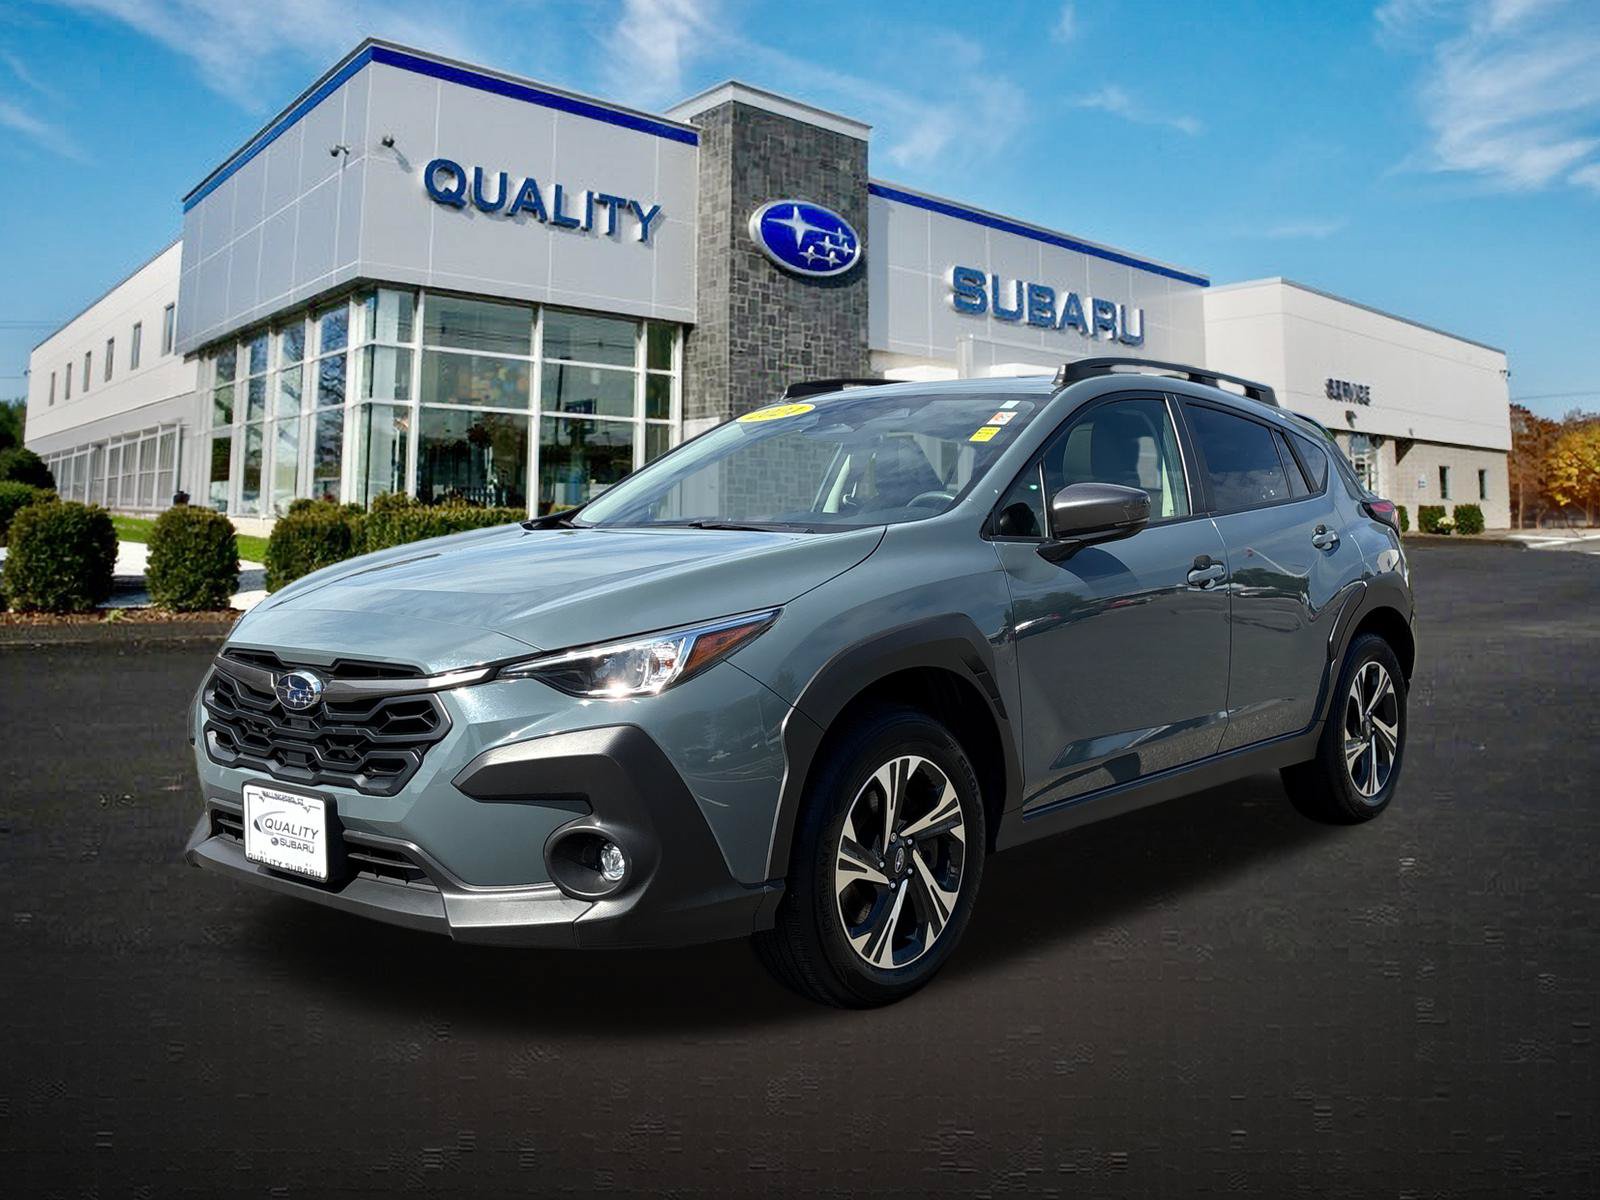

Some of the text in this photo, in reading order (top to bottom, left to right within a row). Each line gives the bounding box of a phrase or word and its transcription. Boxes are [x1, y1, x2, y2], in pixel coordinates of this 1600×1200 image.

[423, 158, 662, 243] QUALITY
[950, 265, 1145, 346] SUBARU
[264, 818, 319, 840] QUALITY
[280, 838, 315, 854] SUBARU
